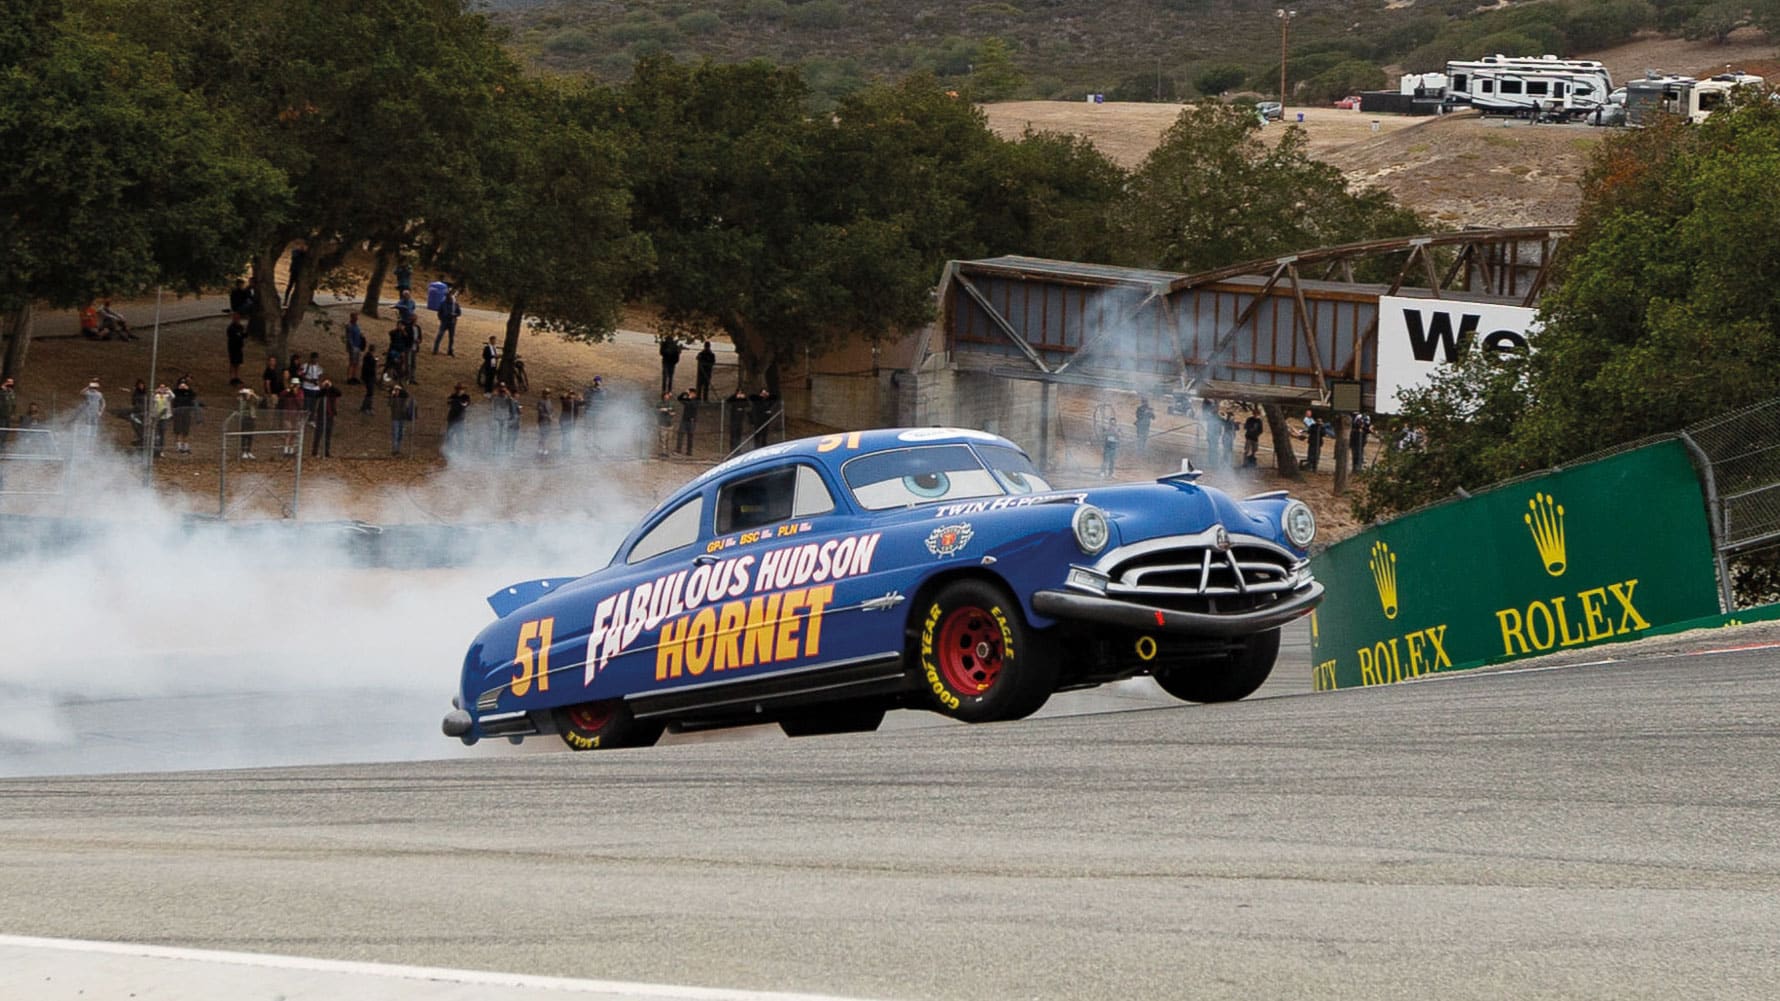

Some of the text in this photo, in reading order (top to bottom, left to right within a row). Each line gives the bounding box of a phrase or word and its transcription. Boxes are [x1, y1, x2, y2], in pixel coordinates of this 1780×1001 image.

[707, 523, 799, 553] GPJ BSC PLN
[935, 502, 988, 518] TWIN
[584, 533, 881, 687] FABULOUS HUDSON
[655, 584, 835, 681] HORNET
[991, 606, 1014, 660] EAGLE
[1496, 579, 1652, 655] ROLEX
[511, 616, 555, 697] 51
[1357, 624, 1453, 688] ROLEX
[567, 730, 600, 749] EAGLE
